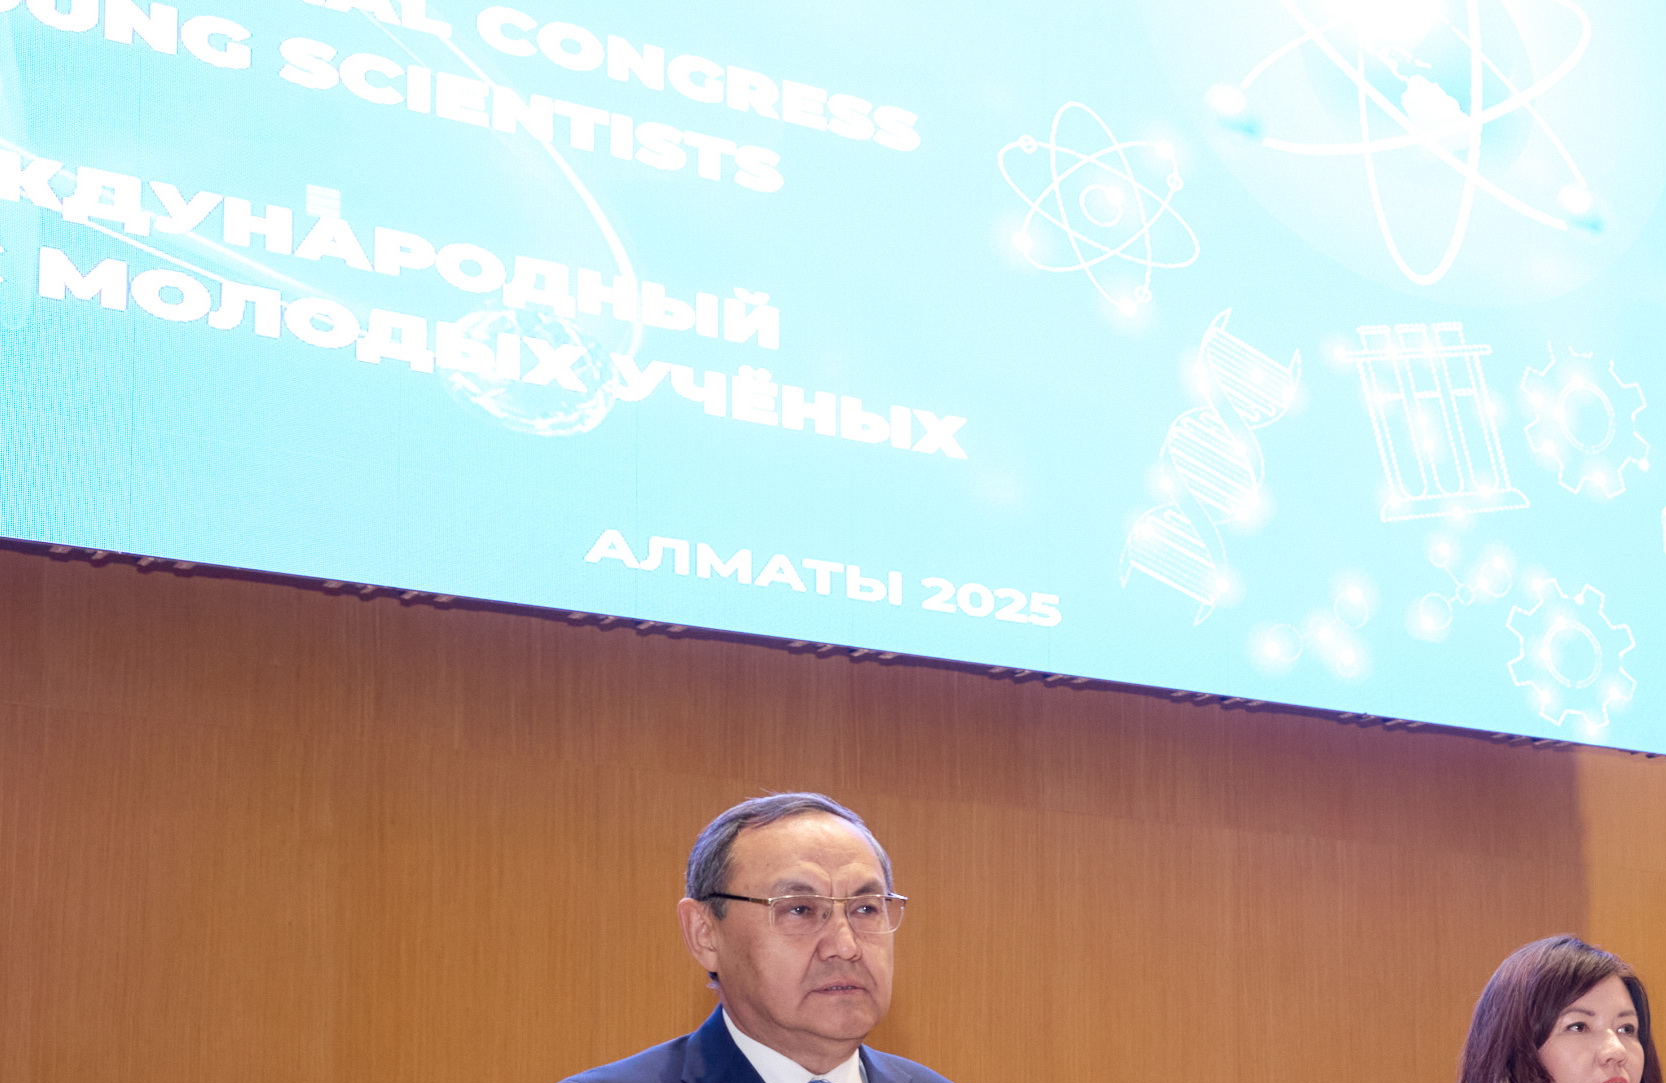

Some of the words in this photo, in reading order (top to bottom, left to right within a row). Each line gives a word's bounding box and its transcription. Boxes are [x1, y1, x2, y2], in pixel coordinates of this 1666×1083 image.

[0, 0, 253, 70] UNG
[278, 37, 785, 194] SCIENTISTS
[477, 5, 921, 152] CONGRESS
[38, 245, 588, 393] МОЛОДЫХ
[609, 352, 969, 459] УЧЁНЫХ
[584, 529, 903, 606] АЛМАТЫ
[920, 576, 1062, 627] 2025
